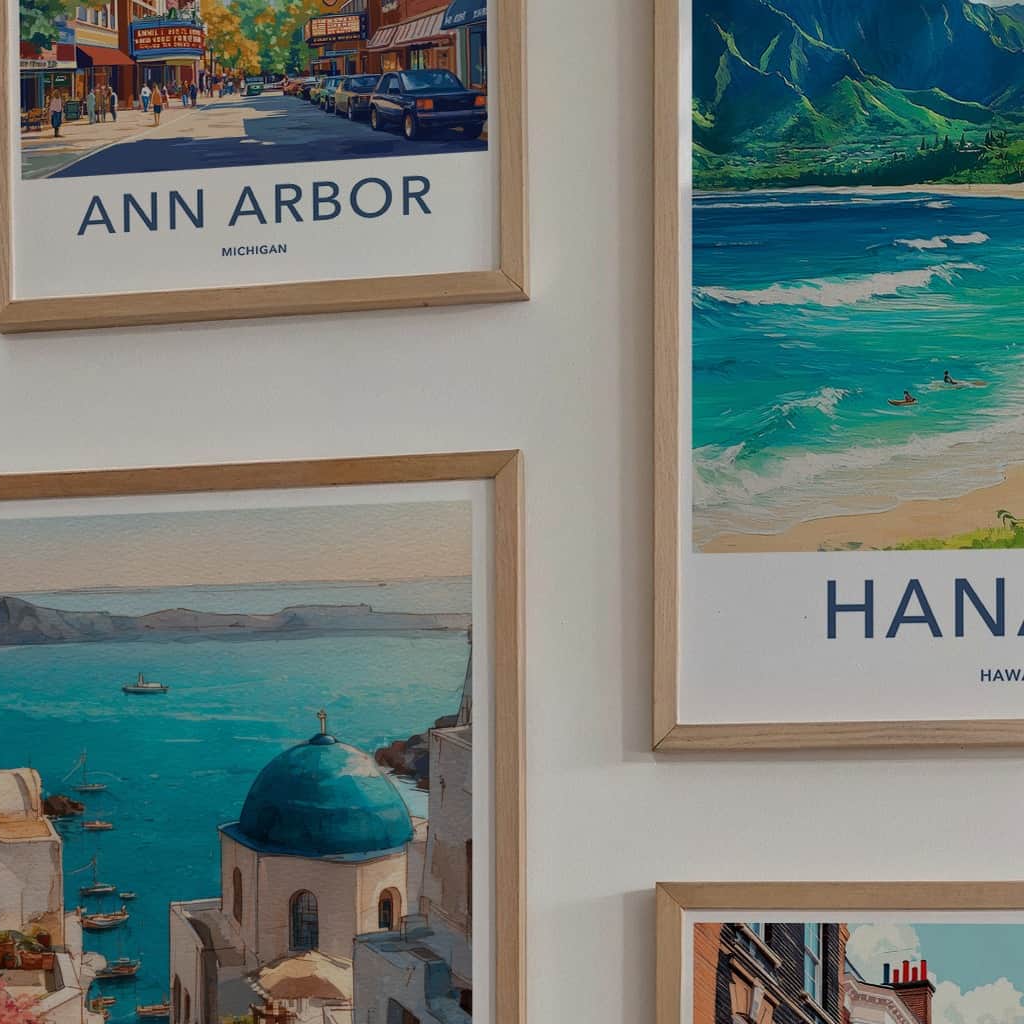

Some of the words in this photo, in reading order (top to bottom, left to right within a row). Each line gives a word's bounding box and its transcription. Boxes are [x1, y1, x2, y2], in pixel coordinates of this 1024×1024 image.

[77, 189, 204, 236] ANN
[228, 175, 432, 227] ARBOR
[221, 243, 288, 257] MICHIGAN
[826, 577, 1024, 640] HAN
[980, 668, 1024, 682] HAW
